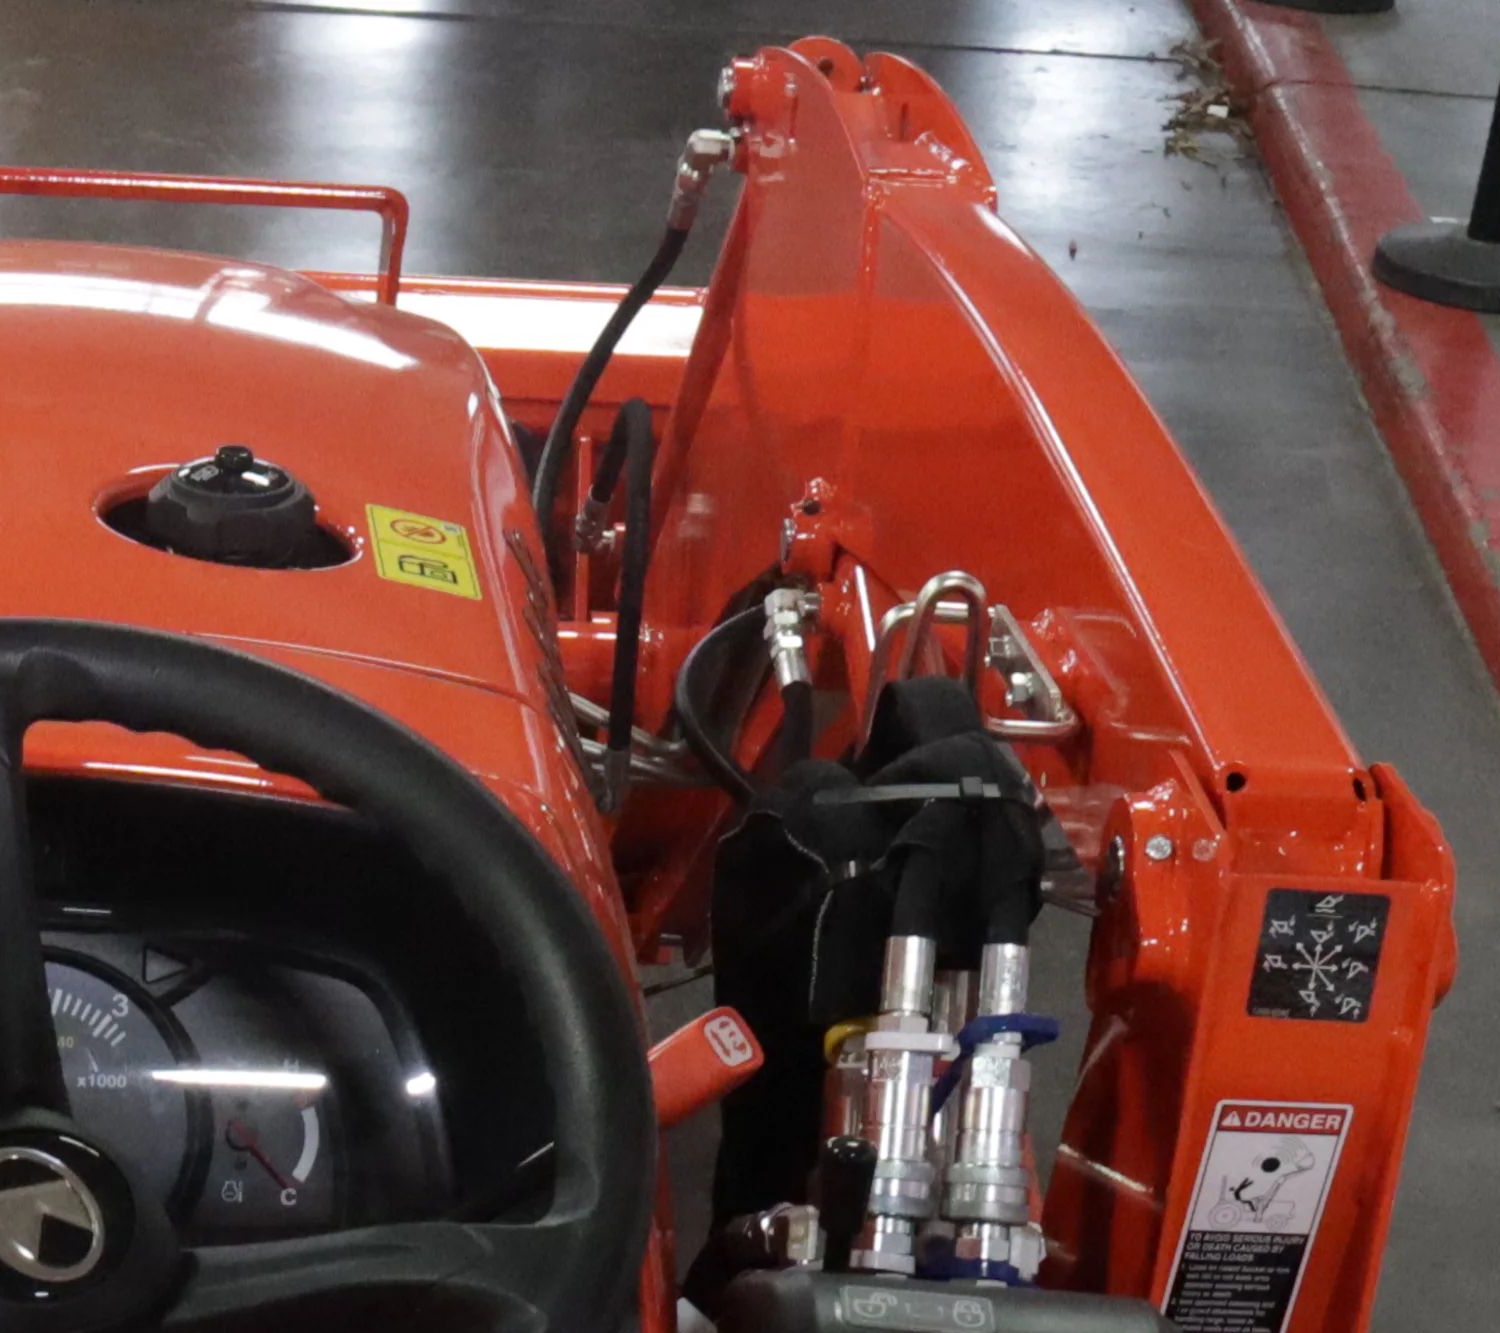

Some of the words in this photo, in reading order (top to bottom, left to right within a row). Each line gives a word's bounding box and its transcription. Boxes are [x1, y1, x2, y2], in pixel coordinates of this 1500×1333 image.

[112, 994, 129, 1016] 3
[76, 1076, 127, 1089] x1000
[1243, 1111, 1342, 1130] DANGER
[280, 1188, 298, 1207] C
